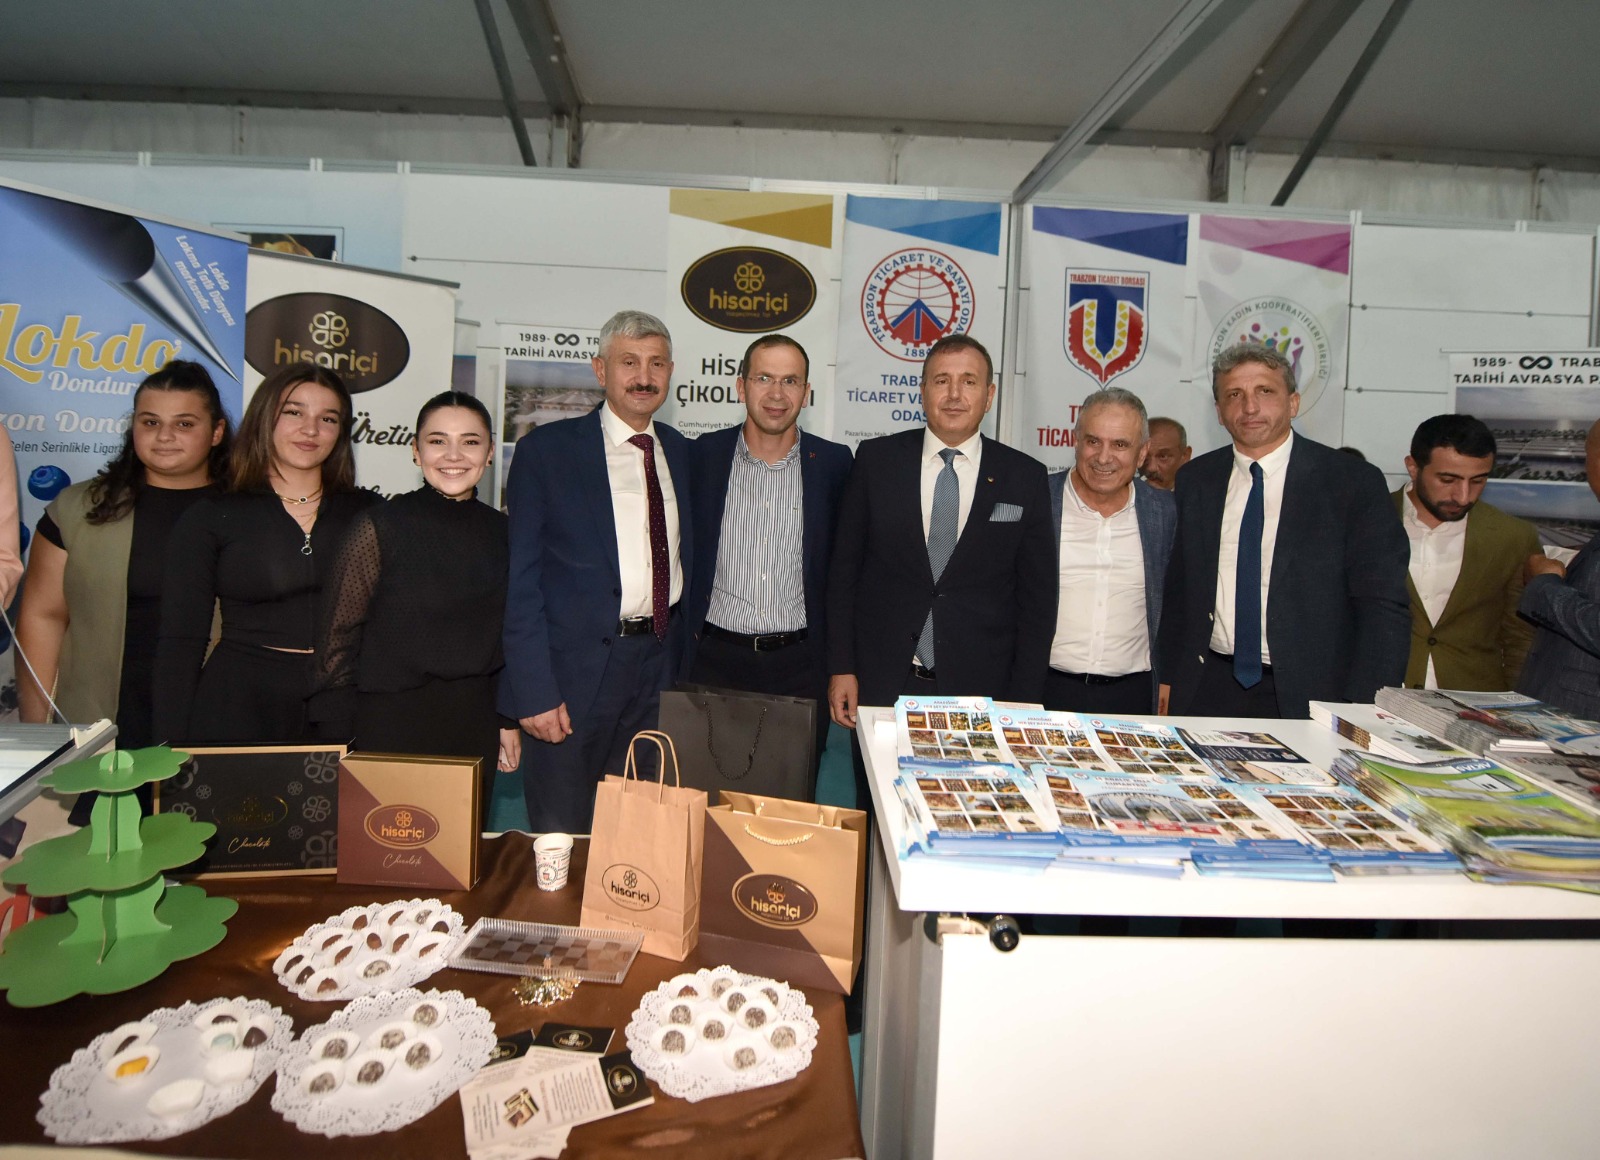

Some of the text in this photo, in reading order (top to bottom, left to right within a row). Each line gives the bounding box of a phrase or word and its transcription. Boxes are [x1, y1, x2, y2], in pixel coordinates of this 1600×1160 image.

[1070, 273, 1097, 283] TRABZON
[1121, 276, 1146, 285] BORSASI
[709, 287, 788, 315] hisariçi
[865, 283, 886, 342] TRABZON
[928, 255, 945, 267] VE
[1226, 306, 1252, 327] KADIN
[0, 303, 178, 384] Lokdo
[504, 346, 545, 357] TARİHİ
[274, 338, 378, 376] hisariçi
[48, 371, 140, 395] Dondur
[1454, 371, 1504, 384] TARİHİ
[1509, 374, 1584, 384] AVRASYA
[847, 387, 905, 404] TİCARET
[678, 421, 721, 429] Cumhuriyet
[41, 441, 90, 453] Serinlikle
[381, 824, 425, 840] hisariçi
[611, 880, 650, 903] hisariçi
[750, 895, 801, 920] hisariçi
